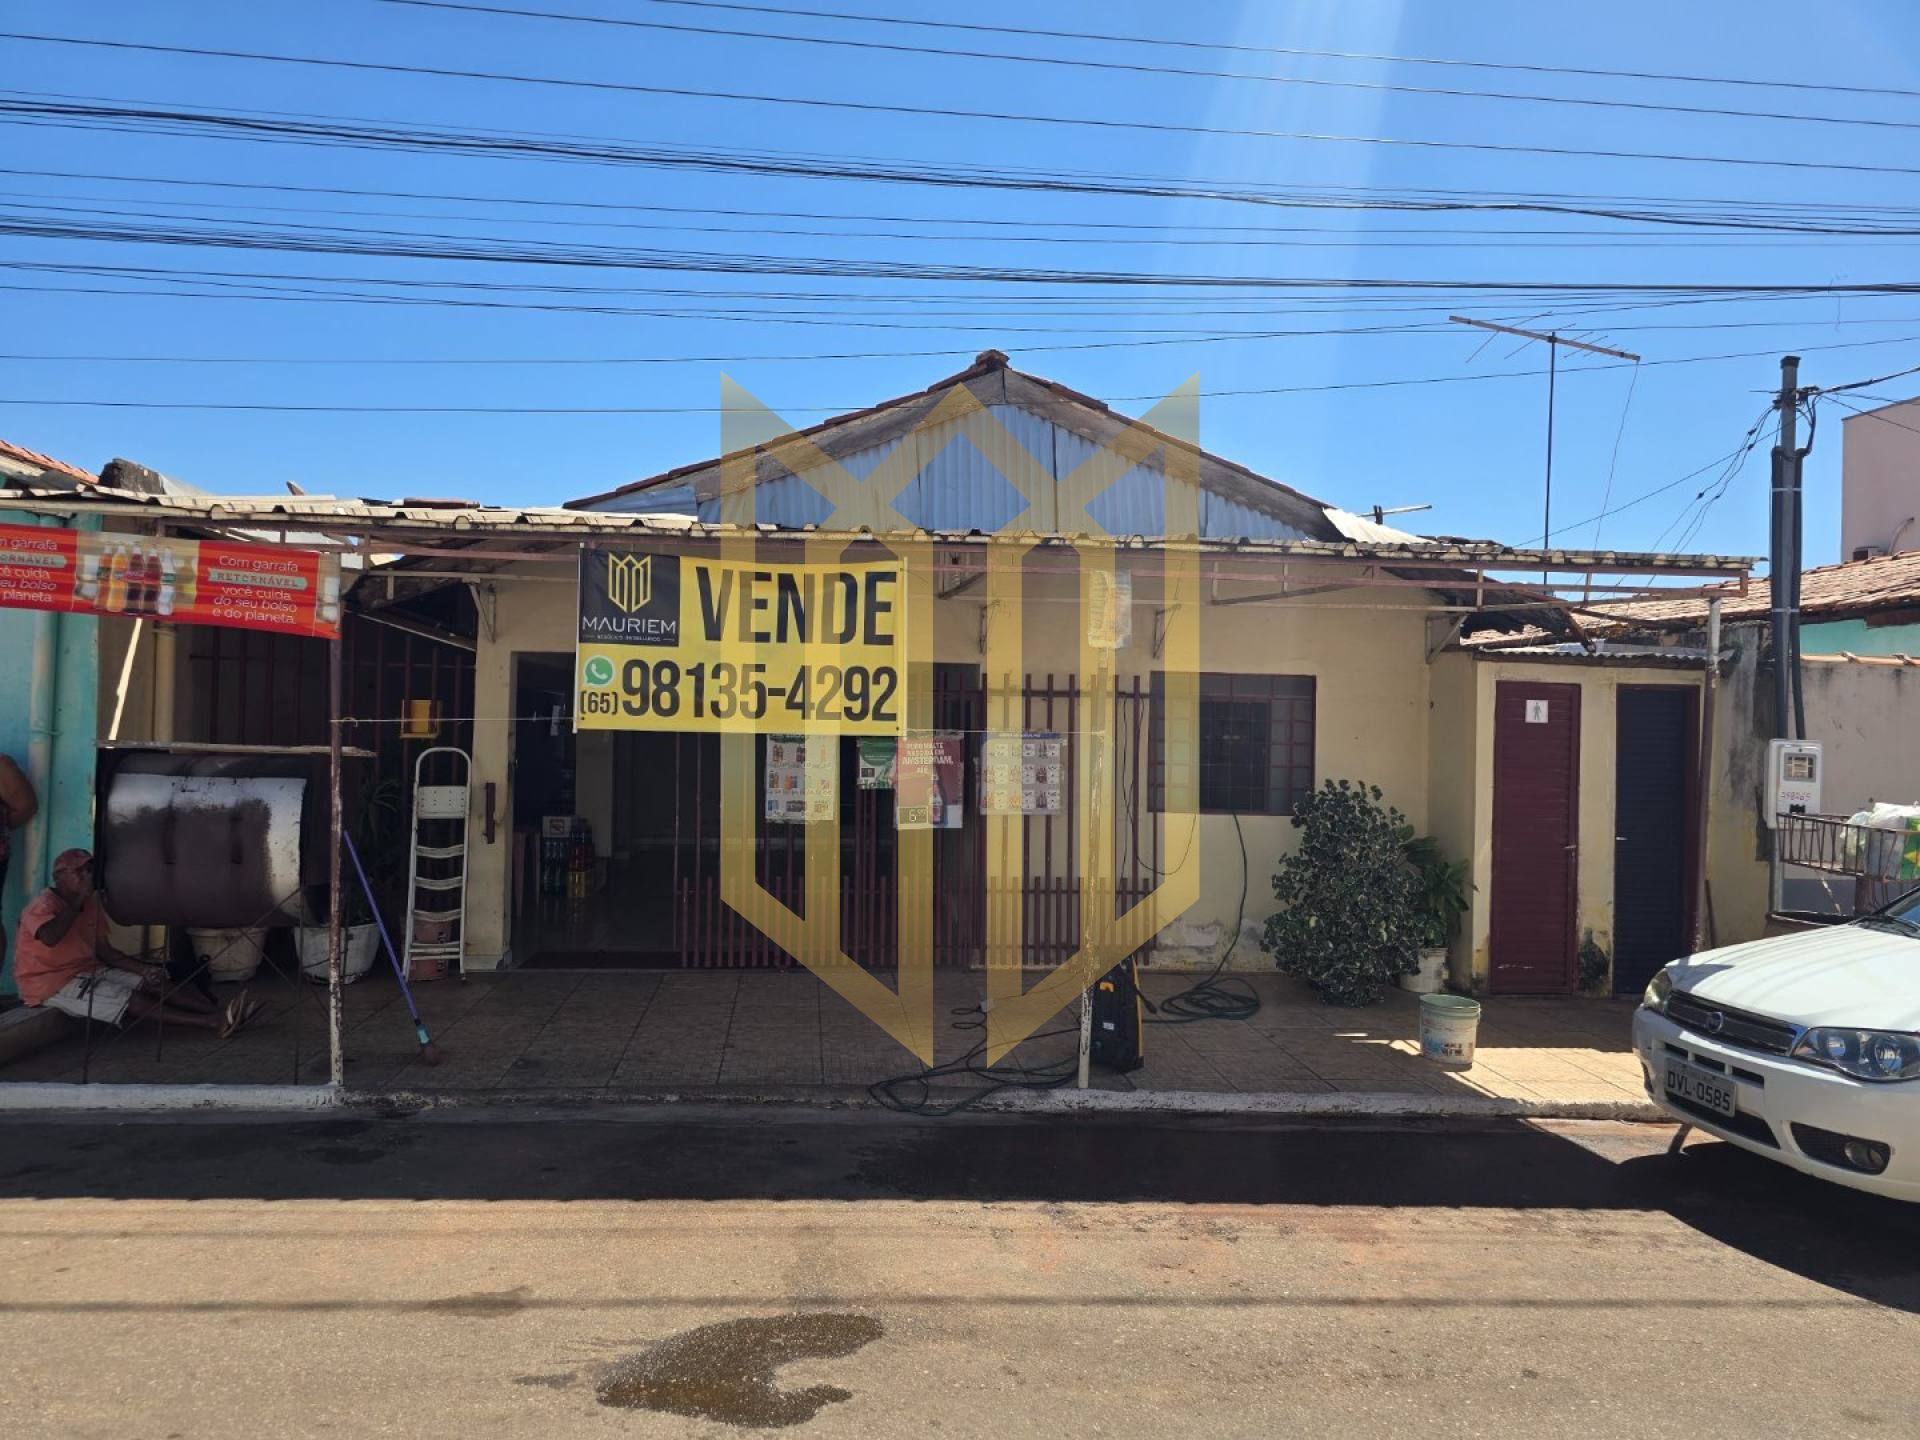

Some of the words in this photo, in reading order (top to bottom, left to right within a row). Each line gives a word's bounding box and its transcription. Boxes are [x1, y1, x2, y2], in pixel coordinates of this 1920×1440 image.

[11, 539, 57, 550] garrafa
[15, 567, 50, 579] cuida
[219, 555, 249, 568] Com
[252, 559, 298, 573] garrafa
[0, 579, 16, 588] eu
[20, 578, 57, 590] bolso
[217, 571, 299, 588] RETORNÁVEL
[222, 585, 253, 597] você
[256, 588, 292, 601] cuida
[212, 607, 221, 617] e
[224, 608, 242, 619] do
[214, 595, 232, 606] do
[235, 599, 258, 609] seu
[261, 600, 298, 613] bolso
[695, 566, 897, 646] VENDE
[582, 615, 676, 635] MAURIEM
[622, 659, 898, 720] 98135-4292
[580, 690, 618, 715] (65)
[1667, 1071, 1730, 1111] DVL-0585
